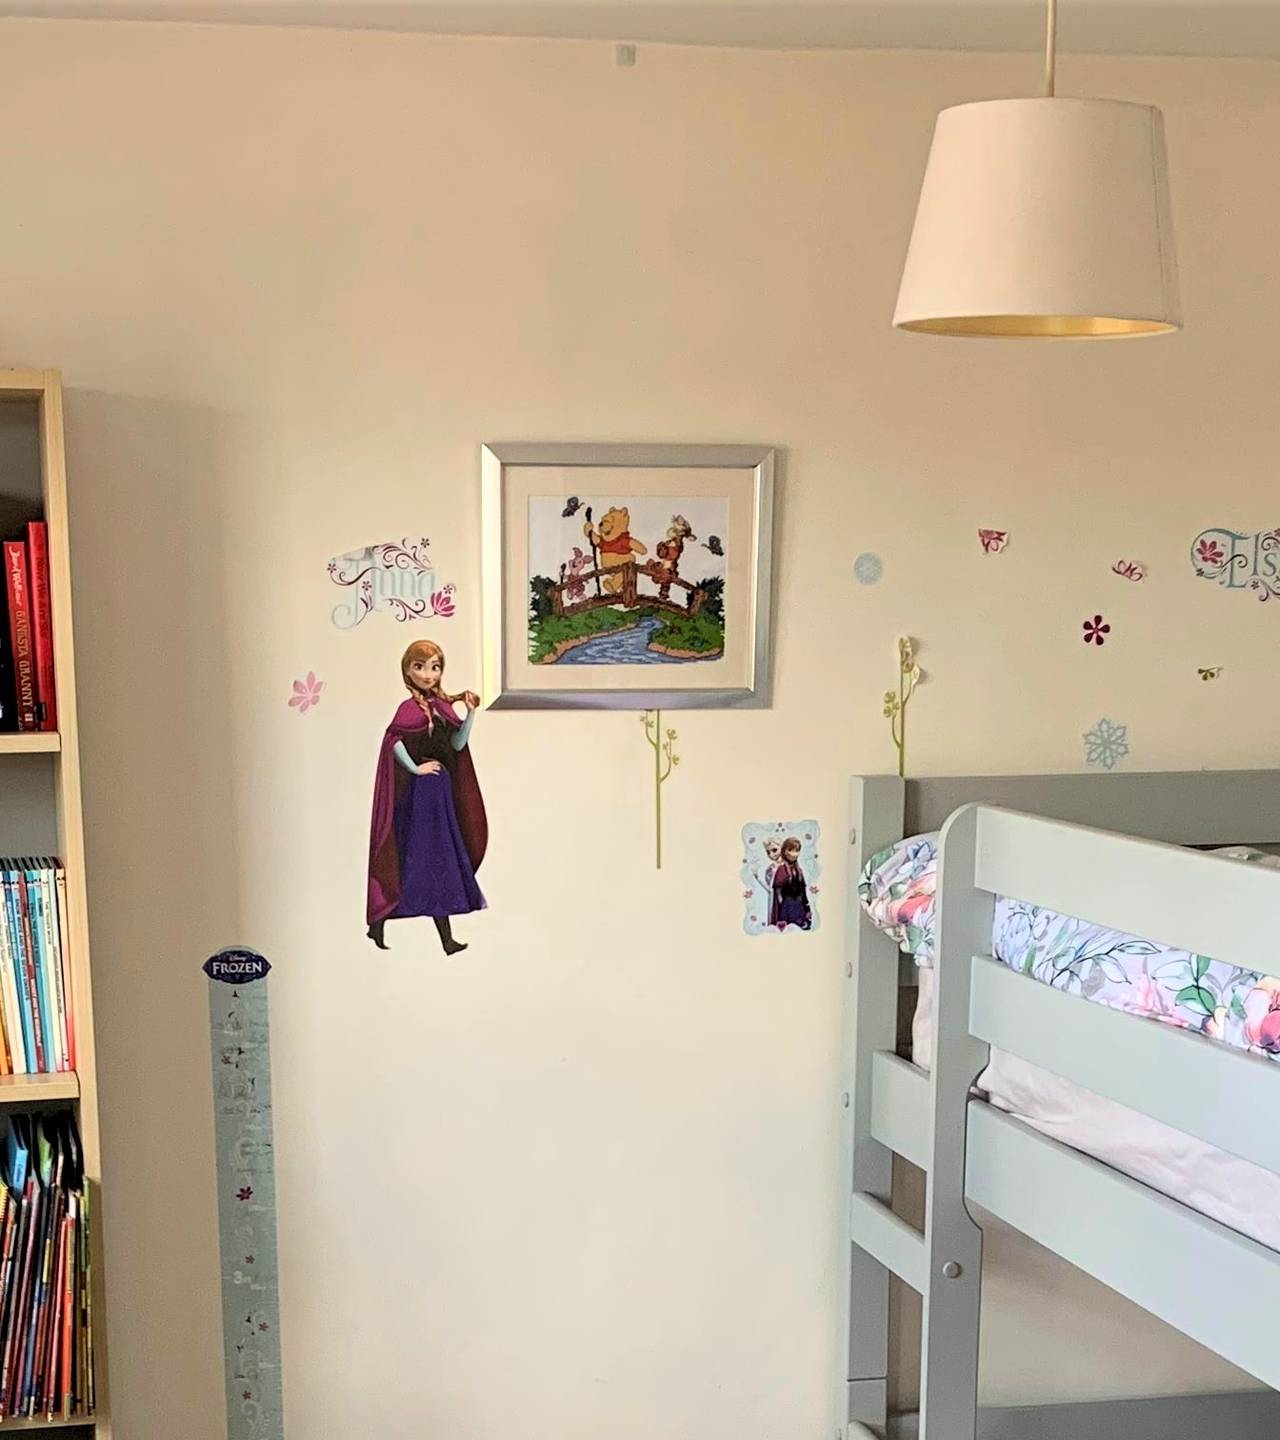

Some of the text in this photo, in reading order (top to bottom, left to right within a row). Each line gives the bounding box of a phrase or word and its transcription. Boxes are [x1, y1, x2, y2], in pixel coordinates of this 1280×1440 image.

[15, 610, 27, 657] GANGSTA
[19, 660, 32, 707] GRANNY
[212, 961, 263, 975] FROZEN
